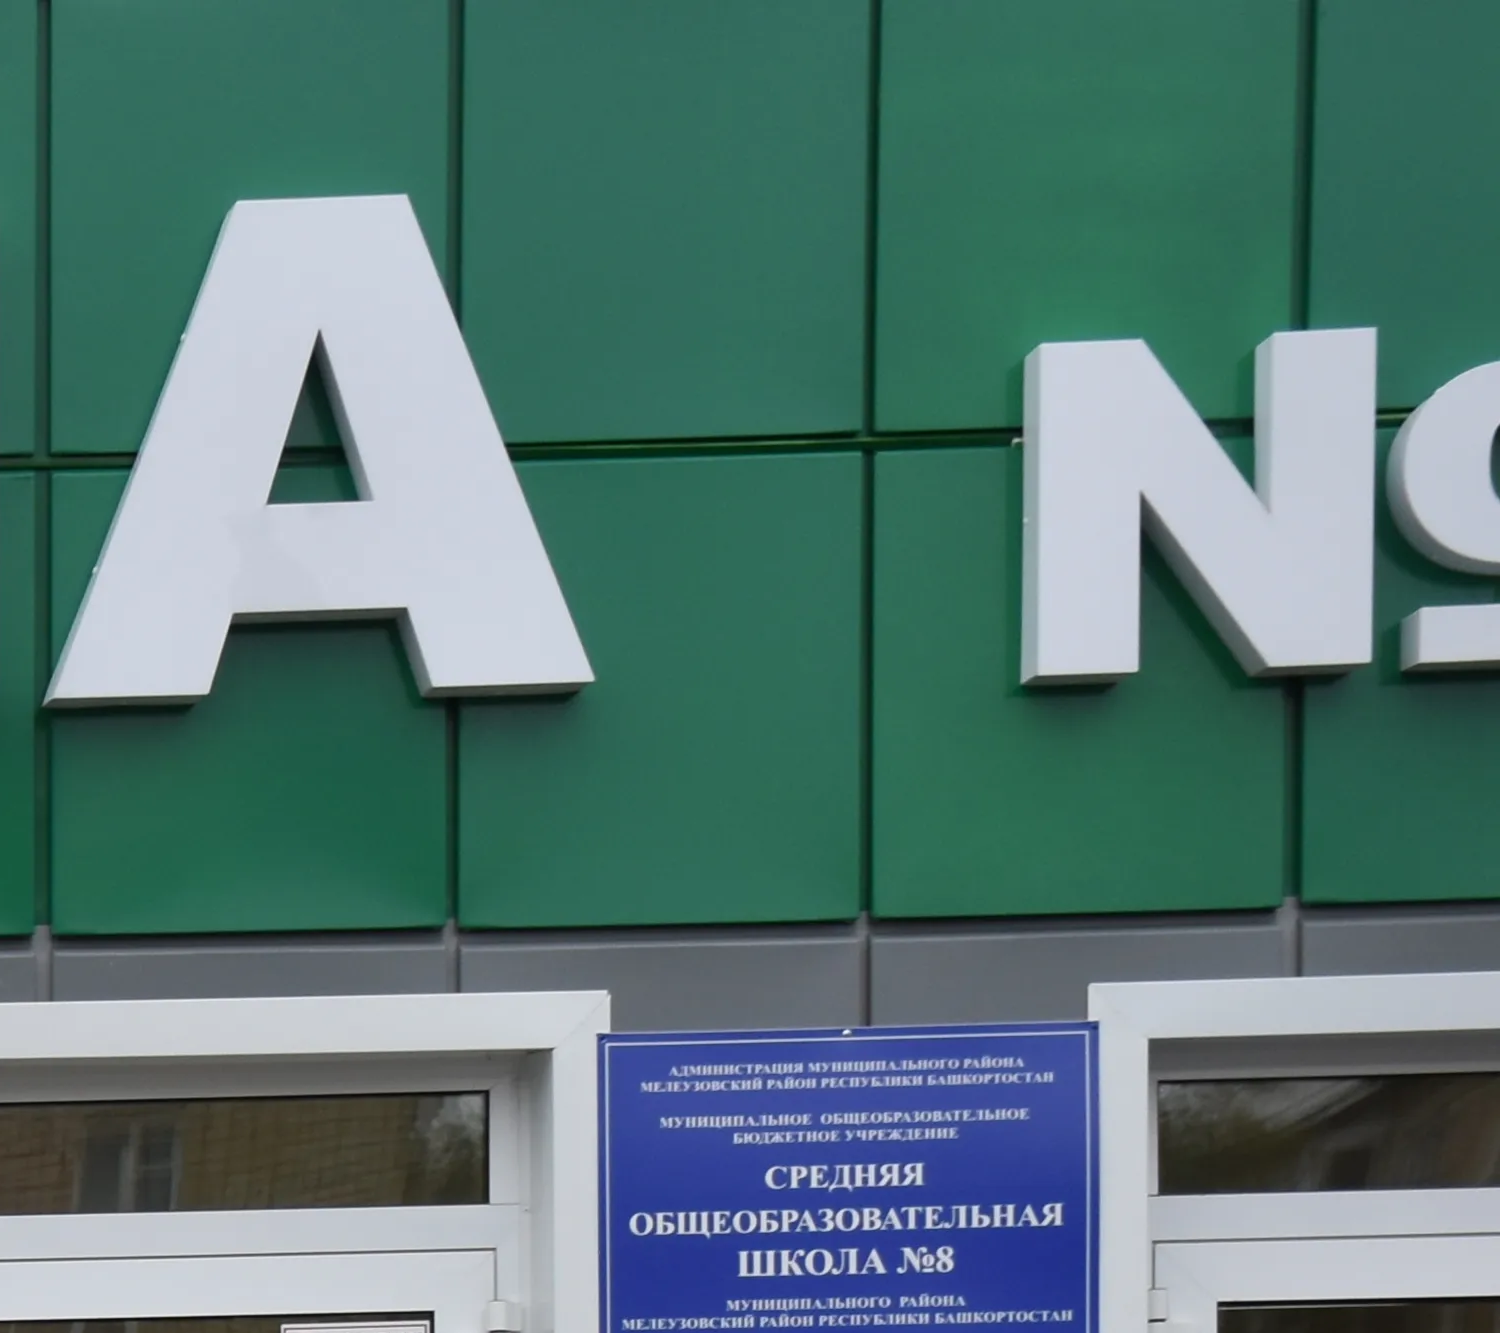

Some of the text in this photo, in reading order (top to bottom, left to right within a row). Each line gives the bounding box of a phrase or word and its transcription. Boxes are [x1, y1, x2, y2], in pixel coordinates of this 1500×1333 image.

[669, 1056, 1025, 1077] АДМИНИСТРАЦИЯ МУНИЦИПАЛЬНОГО РАЙОНА
[640, 1071, 1054, 1093] МЕЛЕУЗОВСКИЙ РАЙОН РЕСПУБЛИКИ БАШКОРТОСТАН
[659, 1108, 1029, 1129] МУНИЦИПАЛЬНОЕ ОБЩЕОБРАЗОВАТЕЛЬНОЕ
[733, 1127, 959, 1145] БЮДЖЕТНОЕ УЧРЕЖДЕНИЕ
[765, 1163, 924, 1191] СРЕДНЯЯ
[629, 1203, 1063, 1238] ОБЩЕОБРАЗОВАТЕЛЬНАЯ
[738, 1246, 955, 1277] ШКОЛА №8
[726, 1293, 966, 1312] МУНИЦИПАЛЬНОГО РАЙОНА
[622, 1310, 1073, 1331] МЕЛЕУЗОВСКИЙ РАЙОН РЕСПУБЛИКИ БАШКОРТОСТАН
